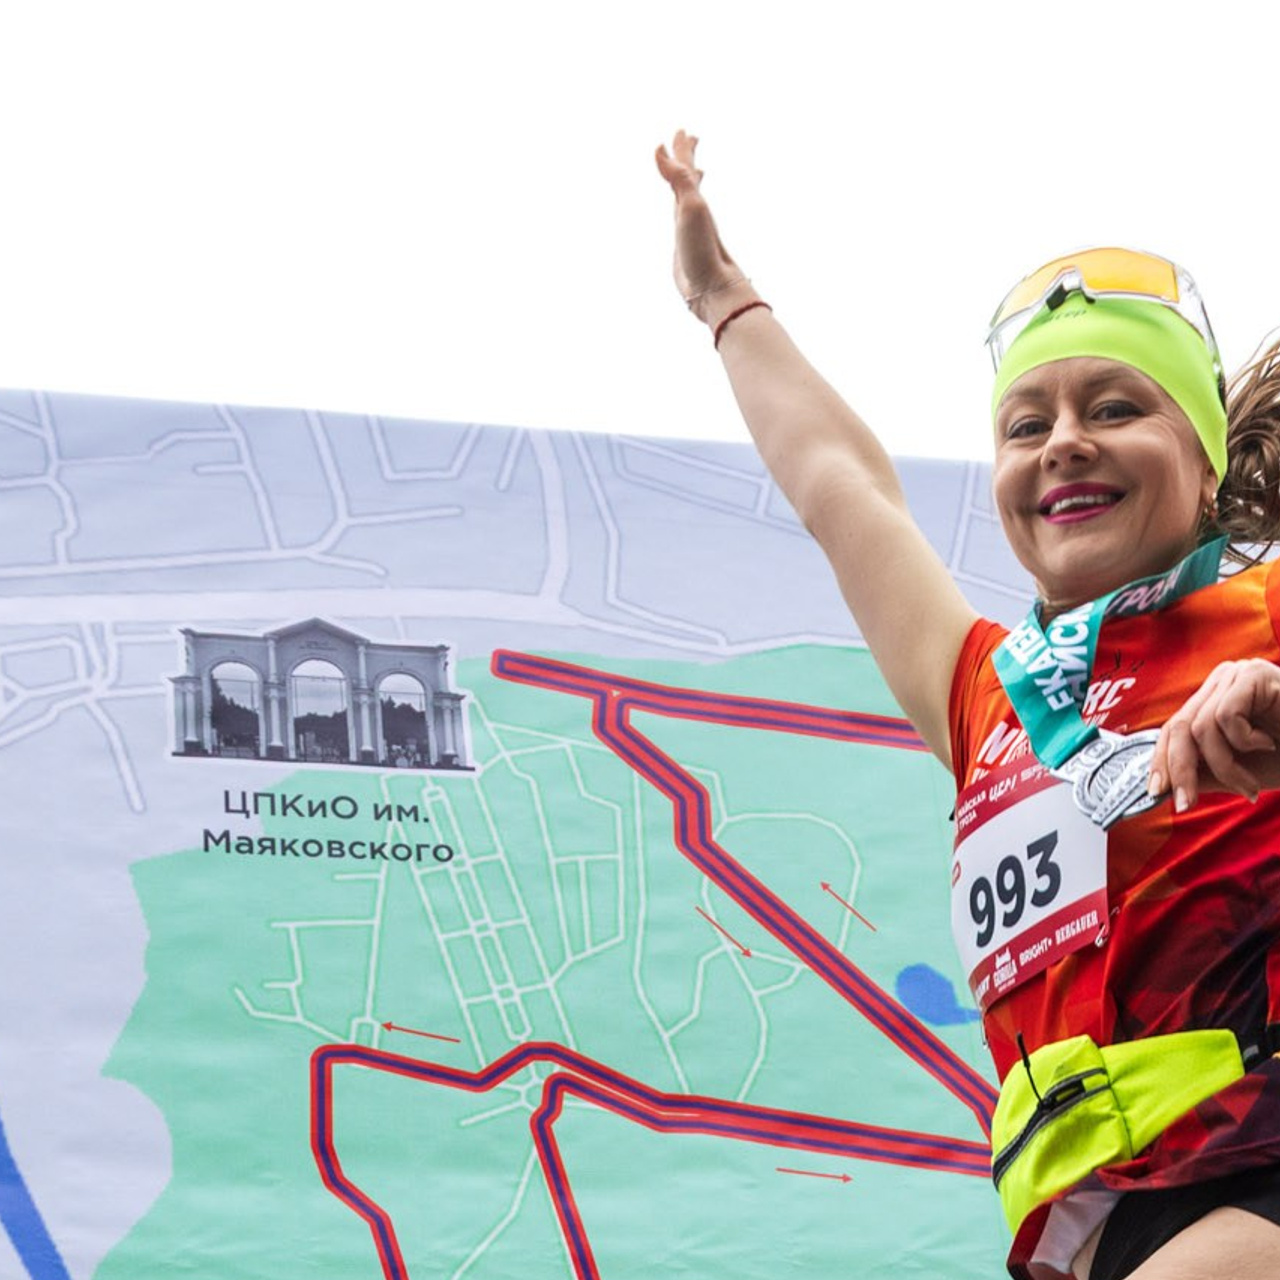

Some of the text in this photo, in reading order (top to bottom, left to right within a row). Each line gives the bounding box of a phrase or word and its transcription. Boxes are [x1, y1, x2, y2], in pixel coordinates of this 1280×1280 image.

[224, 790, 429, 823] ЦПКиО им.
[202, 829, 454, 863] Маяковского
[970, 830, 1061, 948] 993
